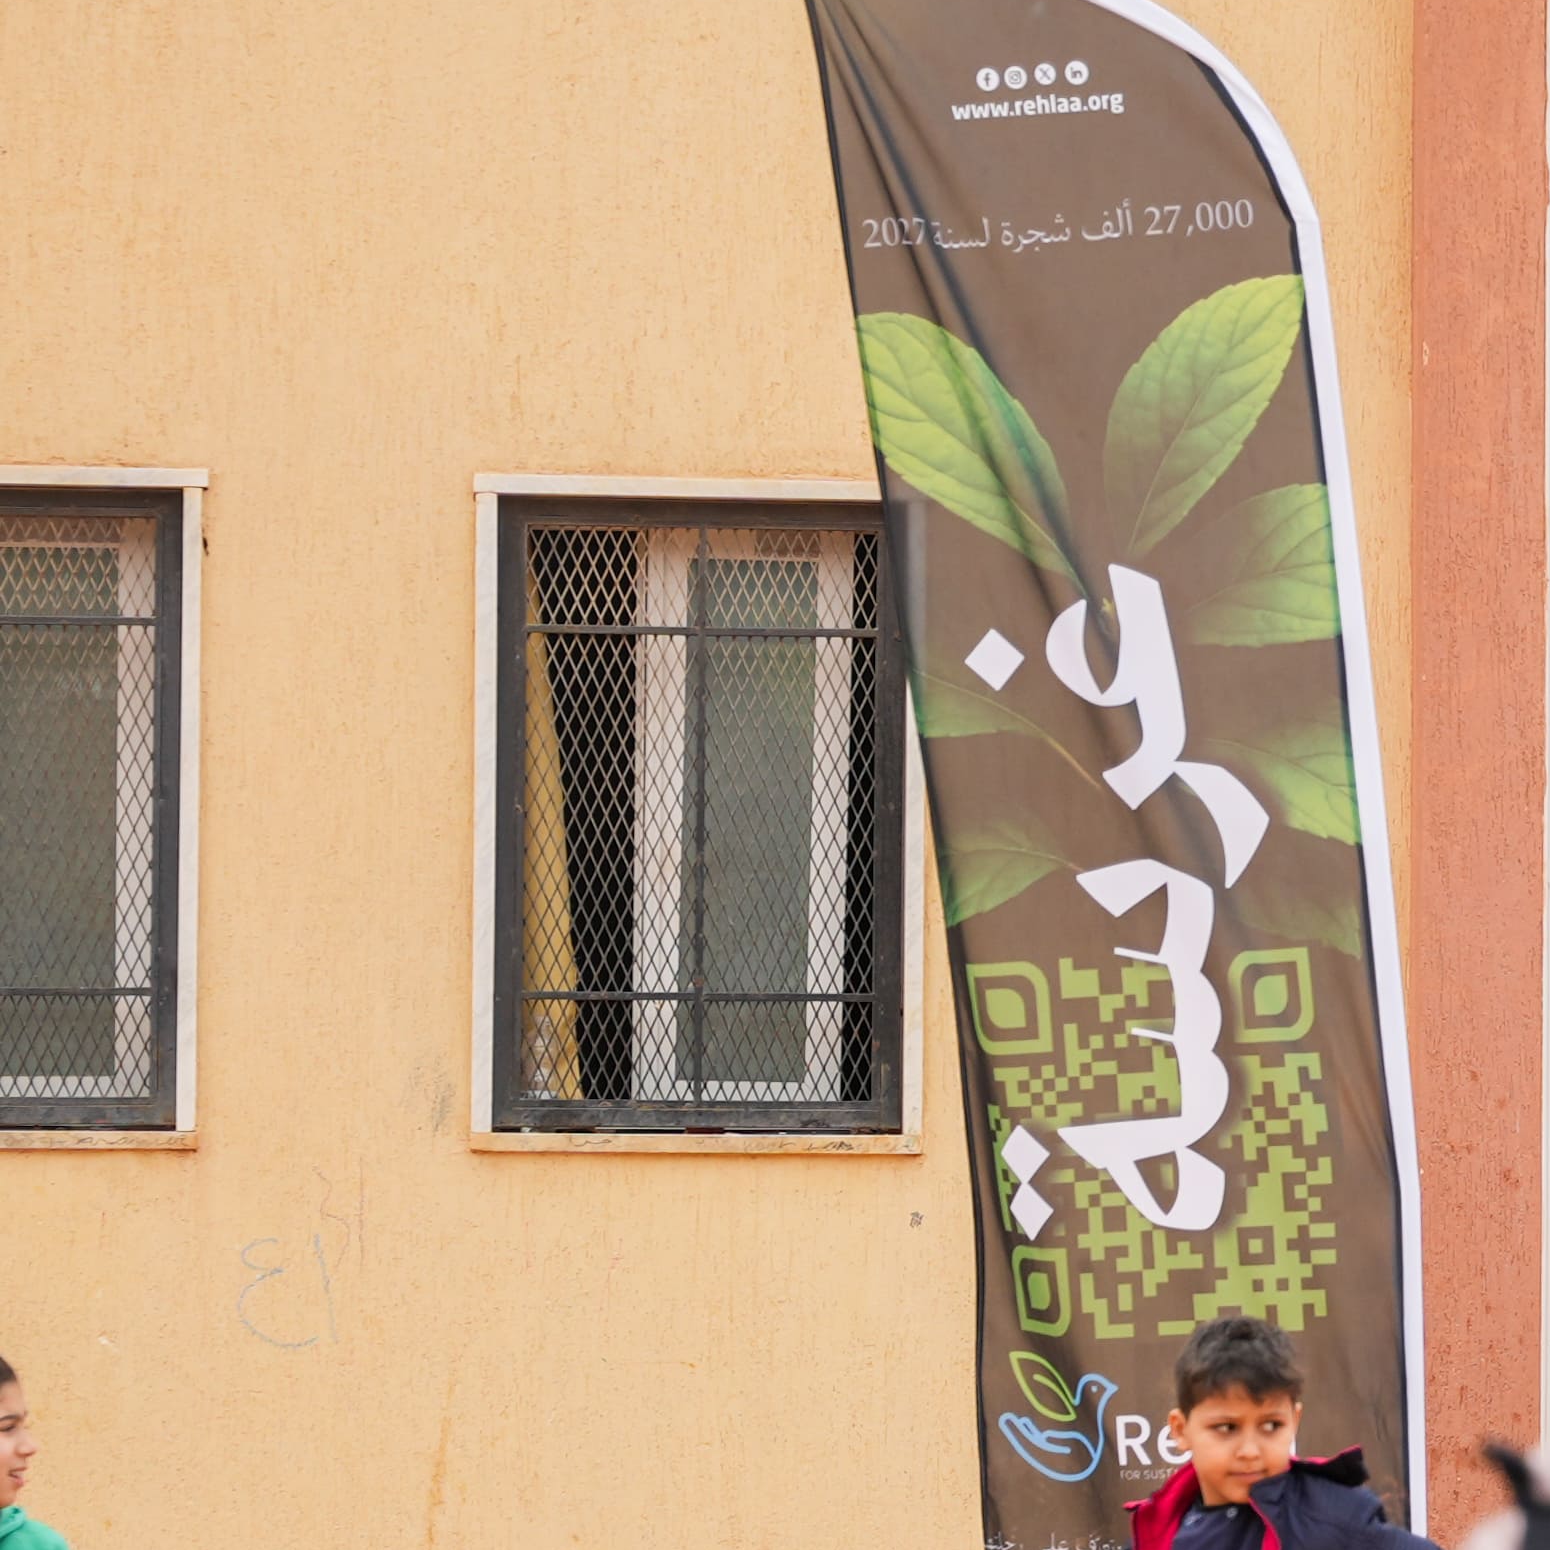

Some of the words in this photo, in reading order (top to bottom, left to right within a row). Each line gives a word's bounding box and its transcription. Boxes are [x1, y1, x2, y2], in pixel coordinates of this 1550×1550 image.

[951, 90, 1124, 121] www.rehlaa.org
[933, 216, 991, 250] لسنة
[1001, 213, 1071, 253] شجرة
[1081, 199, 1133, 242] ألف
[1144, 199, 1254, 238] 27,000
